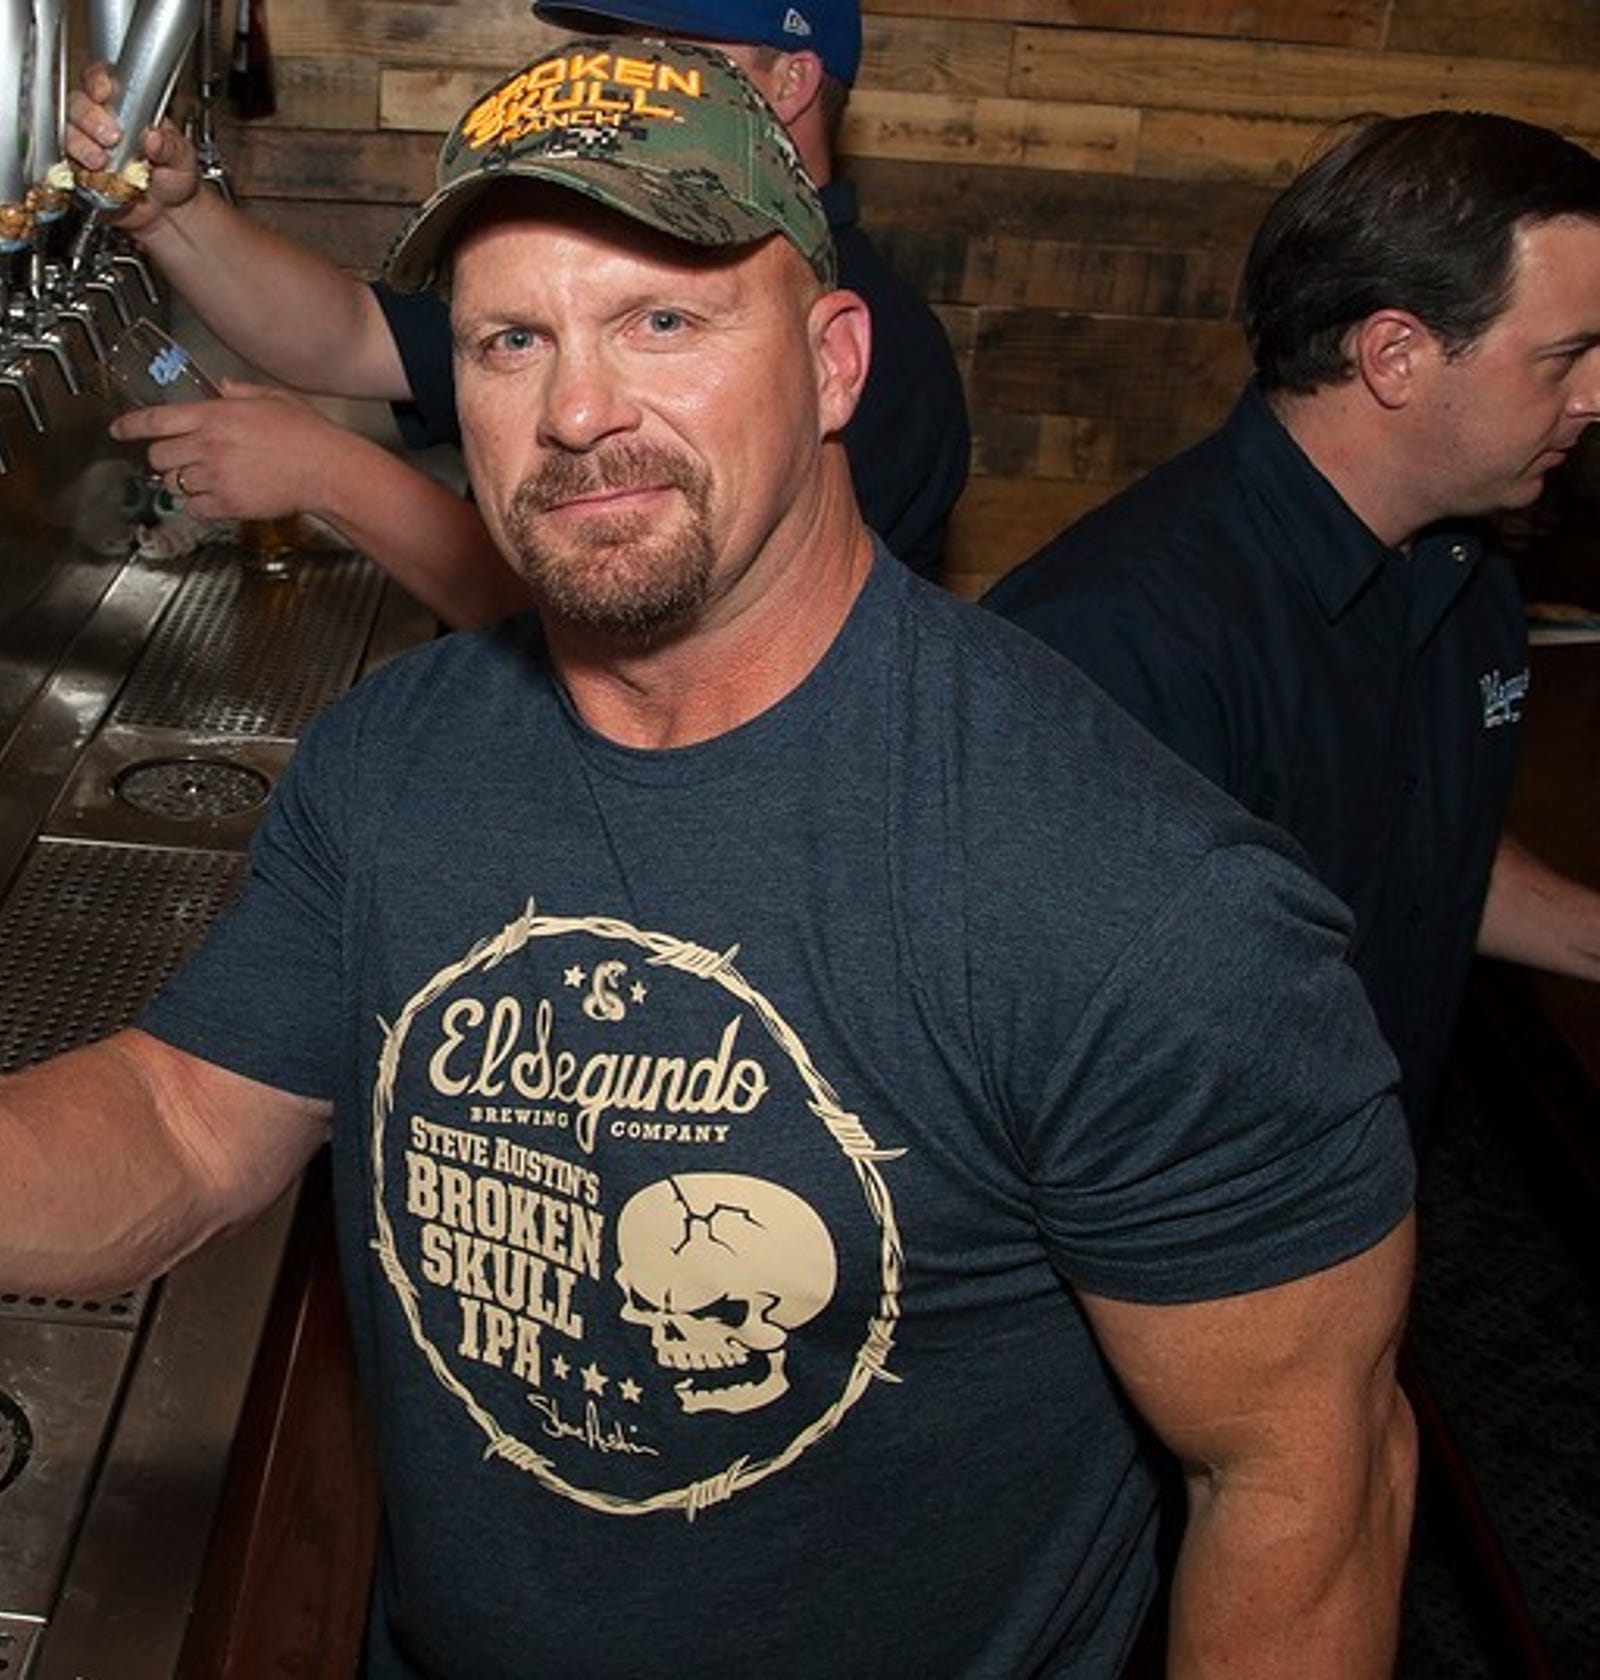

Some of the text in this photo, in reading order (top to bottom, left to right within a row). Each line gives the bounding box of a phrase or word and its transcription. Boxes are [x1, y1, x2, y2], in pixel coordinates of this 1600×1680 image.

[462, 54, 701, 136] BROKEN
[470, 81, 676, 149] SKULL
[410, 1114, 601, 1206] STEVE AUSTIN'S
[469, 1105, 732, 1144] BREWING COMPANY
[405, 1150, 605, 1281] BROKEN
[421, 1222, 584, 1341] SKULL
[457, 1296, 543, 1388] IPA
